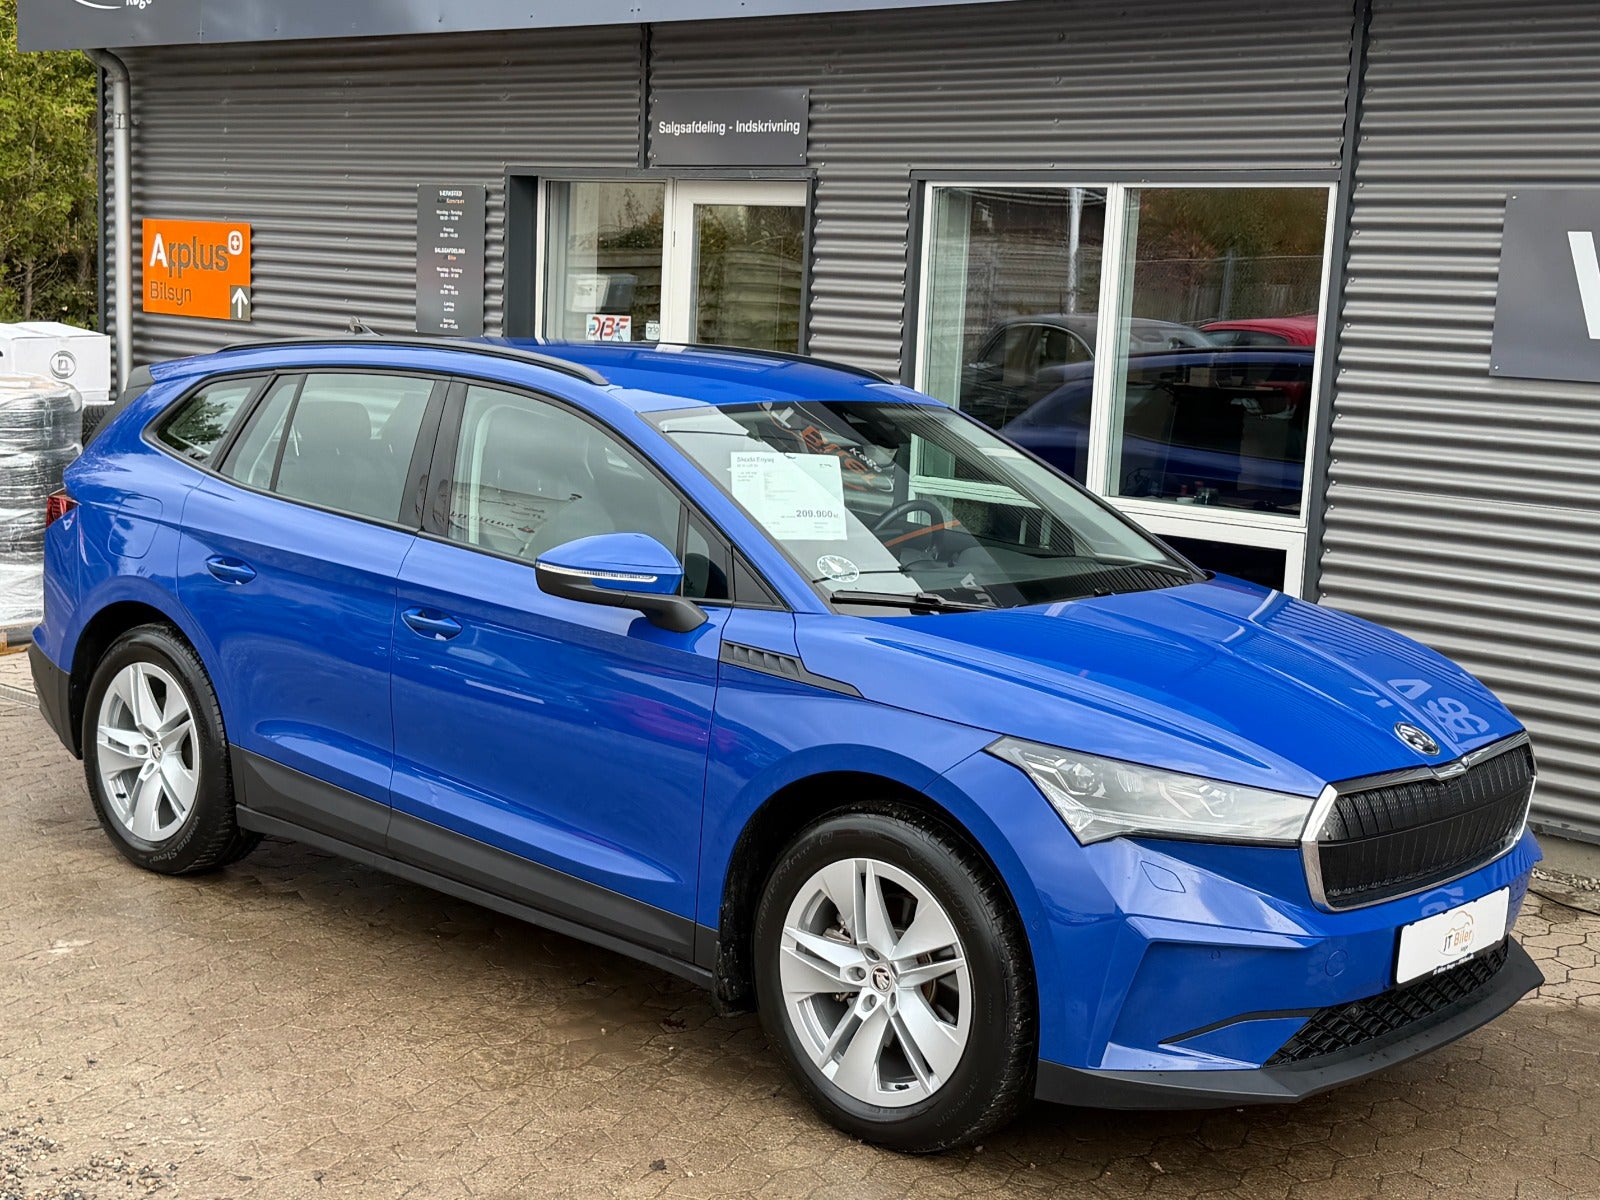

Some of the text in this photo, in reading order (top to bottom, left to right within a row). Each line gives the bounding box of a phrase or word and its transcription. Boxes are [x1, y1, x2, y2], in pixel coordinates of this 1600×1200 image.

[658, 121, 726, 136] Salgsafdeling
[736, 119, 801, 135] Indskrivning
[150, 281, 192, 306] Bilsyn
[1453, 929, 1473, 947] Biler
